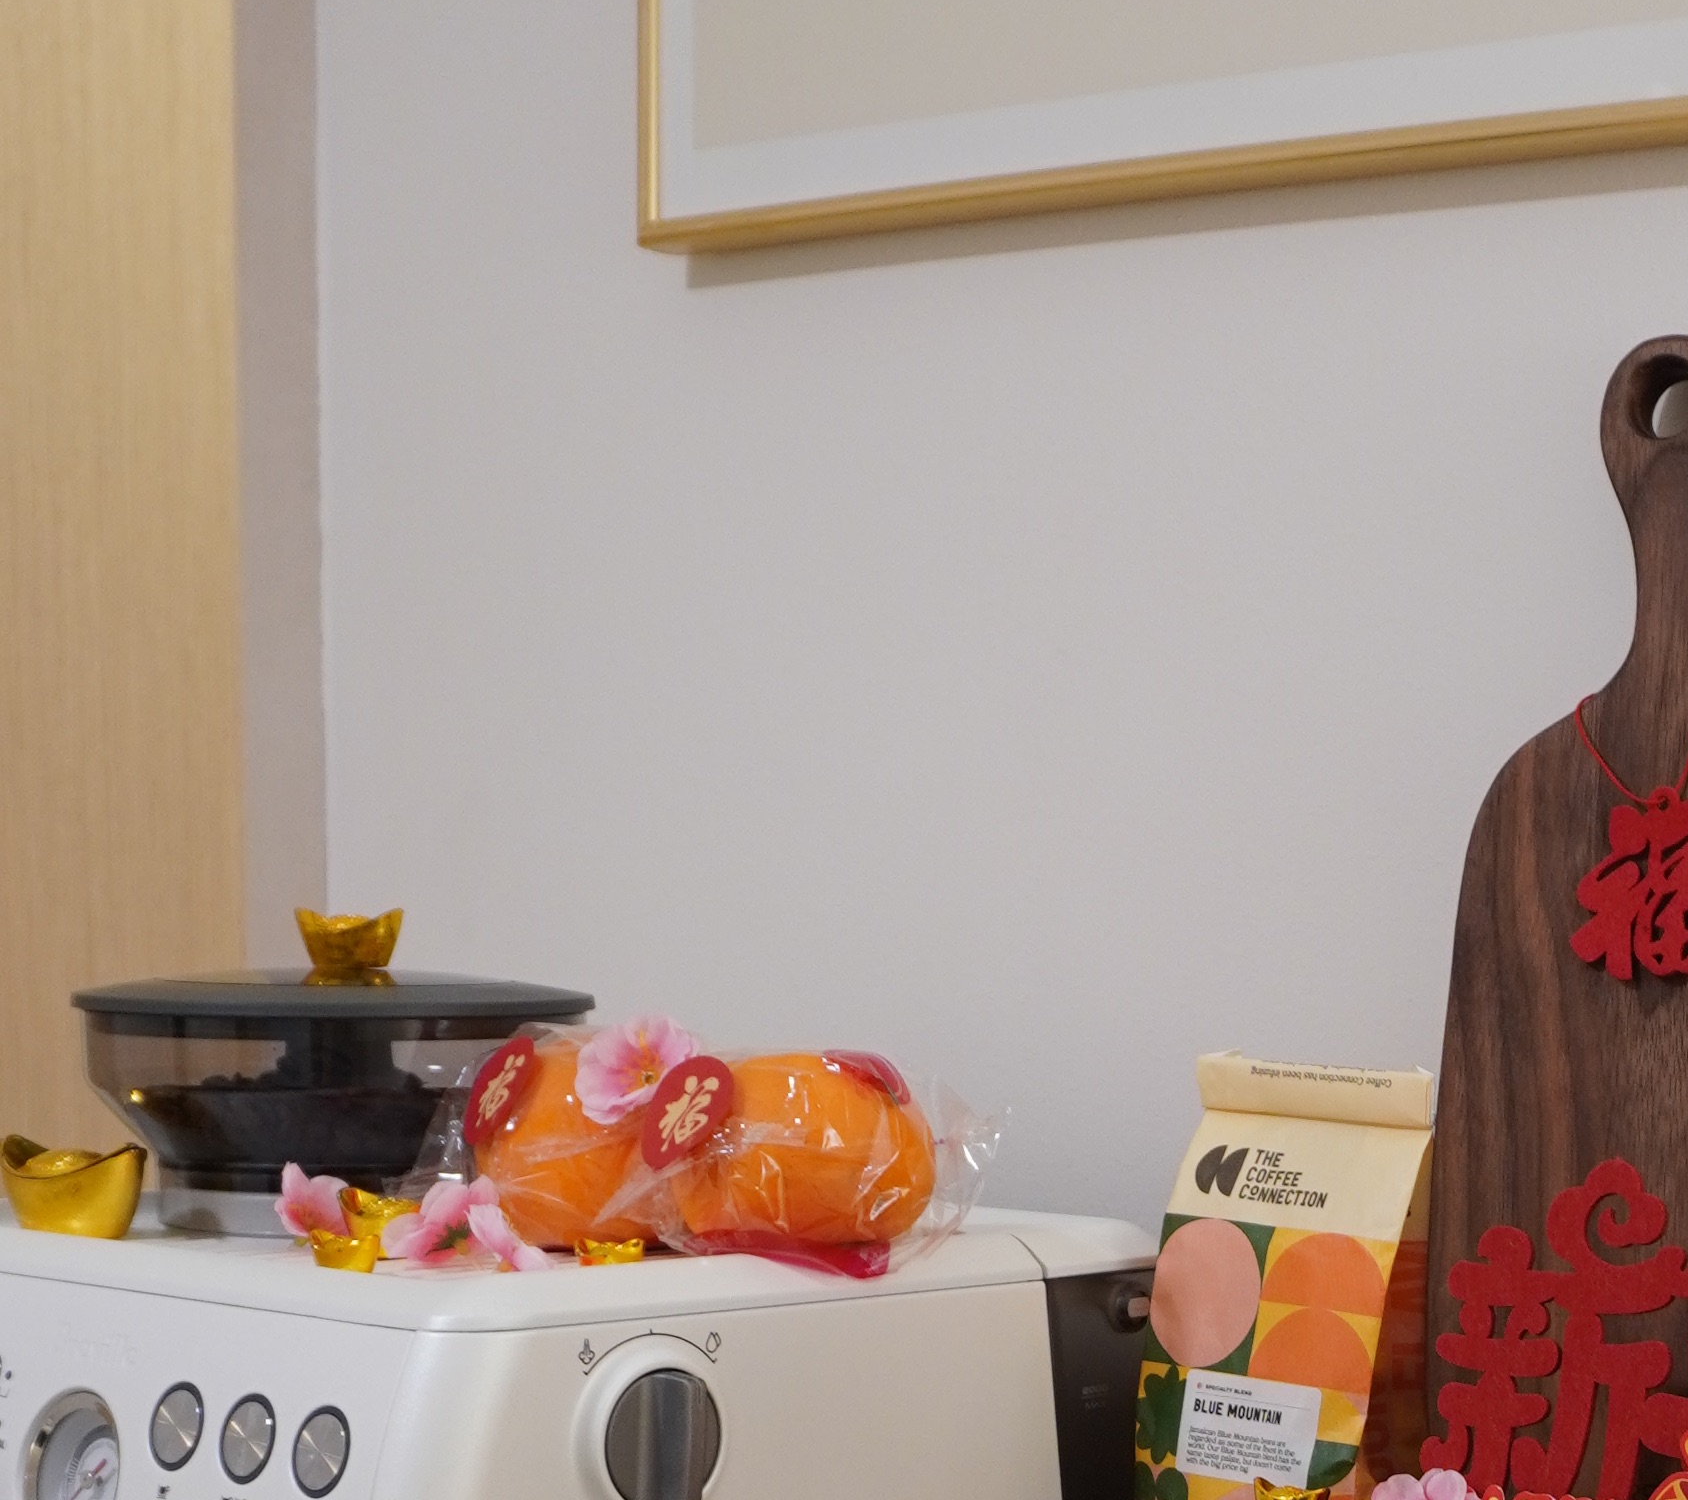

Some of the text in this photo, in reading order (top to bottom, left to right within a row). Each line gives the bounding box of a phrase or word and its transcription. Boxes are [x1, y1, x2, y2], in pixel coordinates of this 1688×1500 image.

[475, 1054, 526, 1128] 福
[658, 1075, 720, 1153] 福
[1254, 1148, 1285, 1168] THE
[1246, 1165, 1303, 1187] COFFEE
[1238, 1184, 1329, 1209] CONNECTION
[1193, 1398, 1282, 1425] BLUE MOUNTAIN
